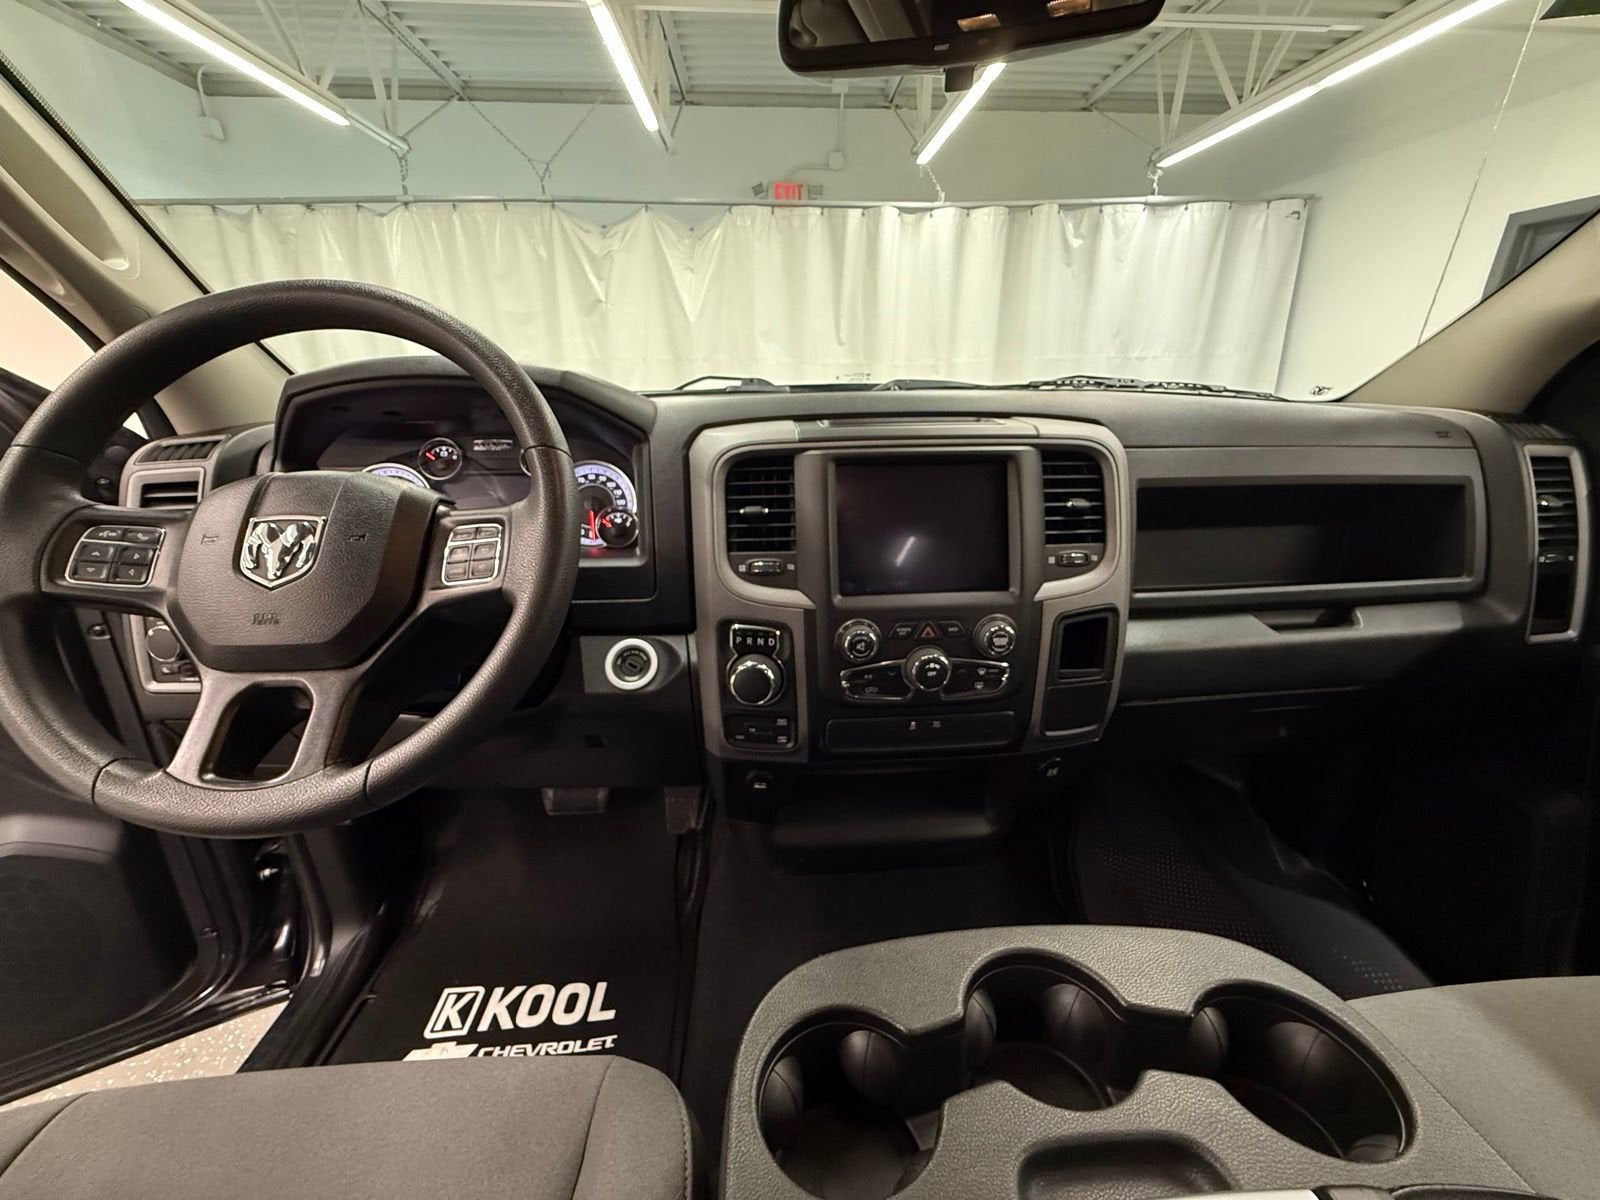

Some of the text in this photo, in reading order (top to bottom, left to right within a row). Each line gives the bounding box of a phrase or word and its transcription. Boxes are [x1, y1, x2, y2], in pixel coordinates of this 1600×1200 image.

[773, 182, 804, 201] EXIT
[735, 636, 776, 646] P R N D
[476, 981, 617, 1032] KOOL
[476, 1034, 618, 1058] CHEVROLET
